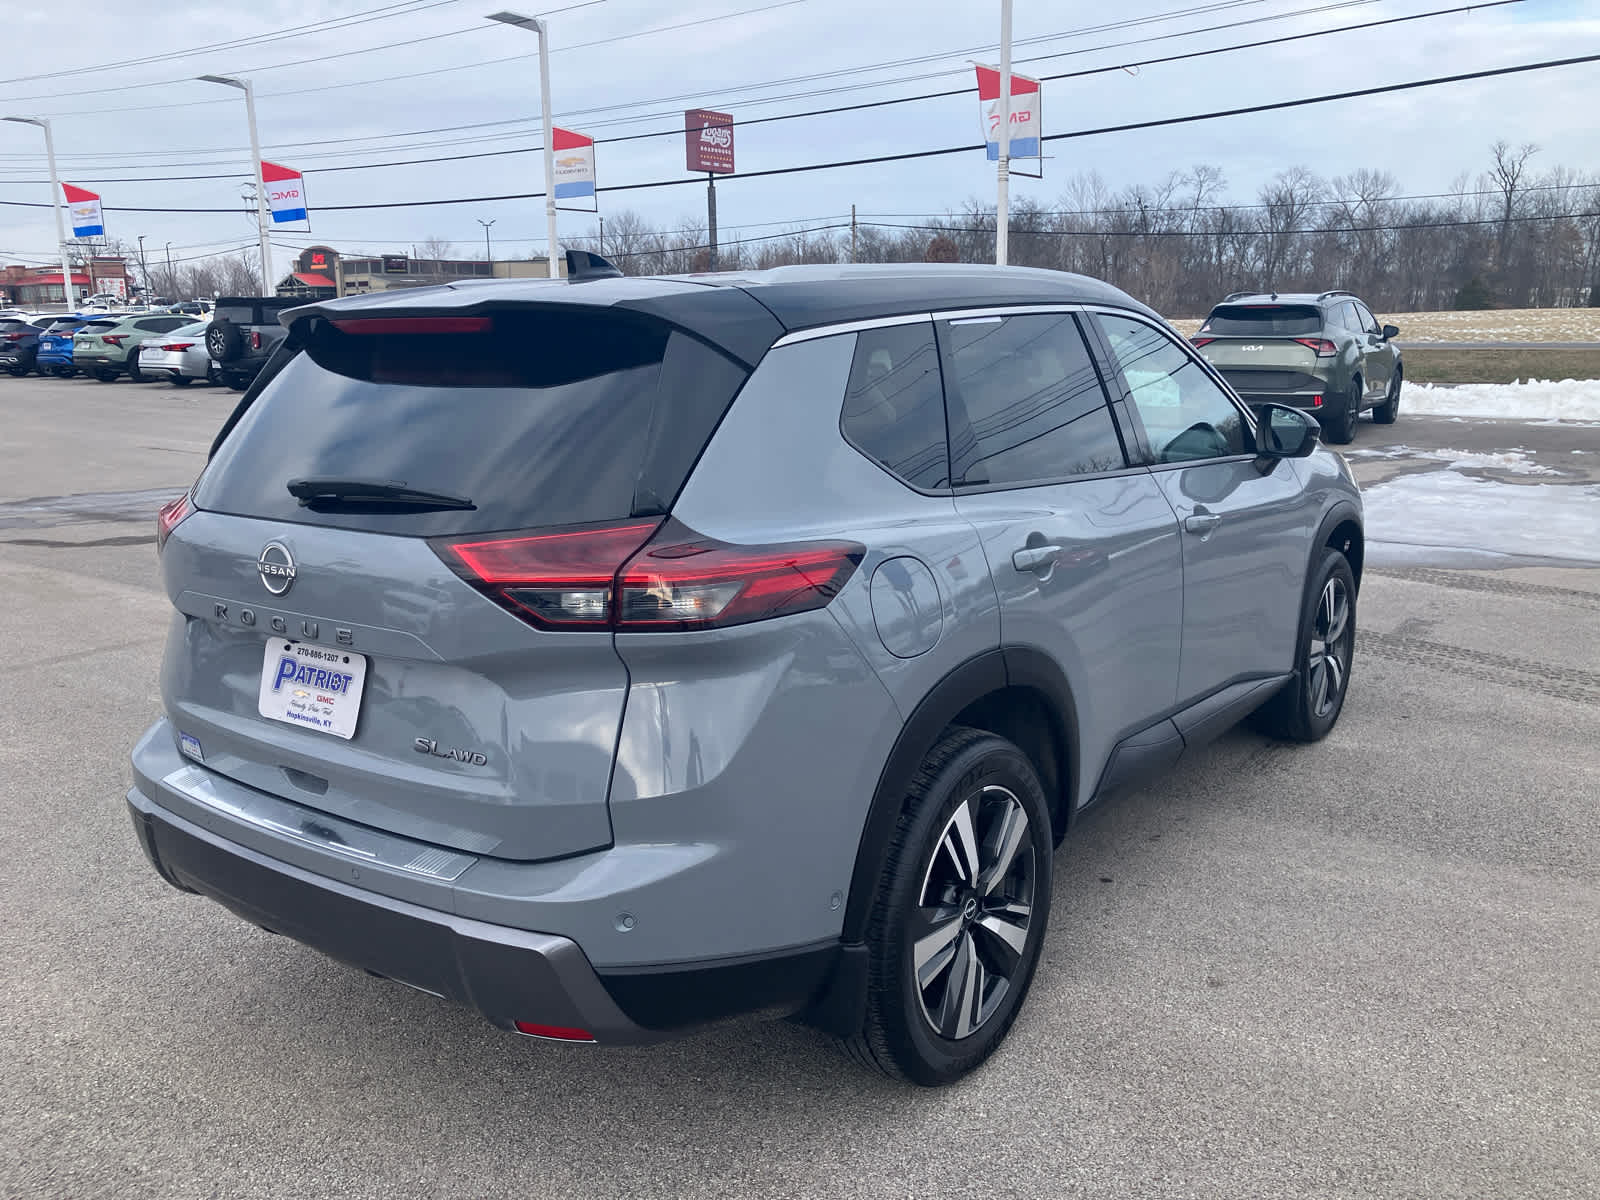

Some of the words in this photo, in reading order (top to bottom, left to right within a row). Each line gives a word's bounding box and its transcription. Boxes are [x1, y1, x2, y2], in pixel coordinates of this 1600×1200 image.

[257, 563, 296, 577] NISSAN
[215, 602, 353, 646] ROGUE
[297, 648, 339, 662] 270-886-1207
[273, 656, 353, 693] PATRIOT
[316, 695, 335, 705] GMC
[286, 710, 322, 727] Hopkinsville,
[322, 719, 332, 728] KY
